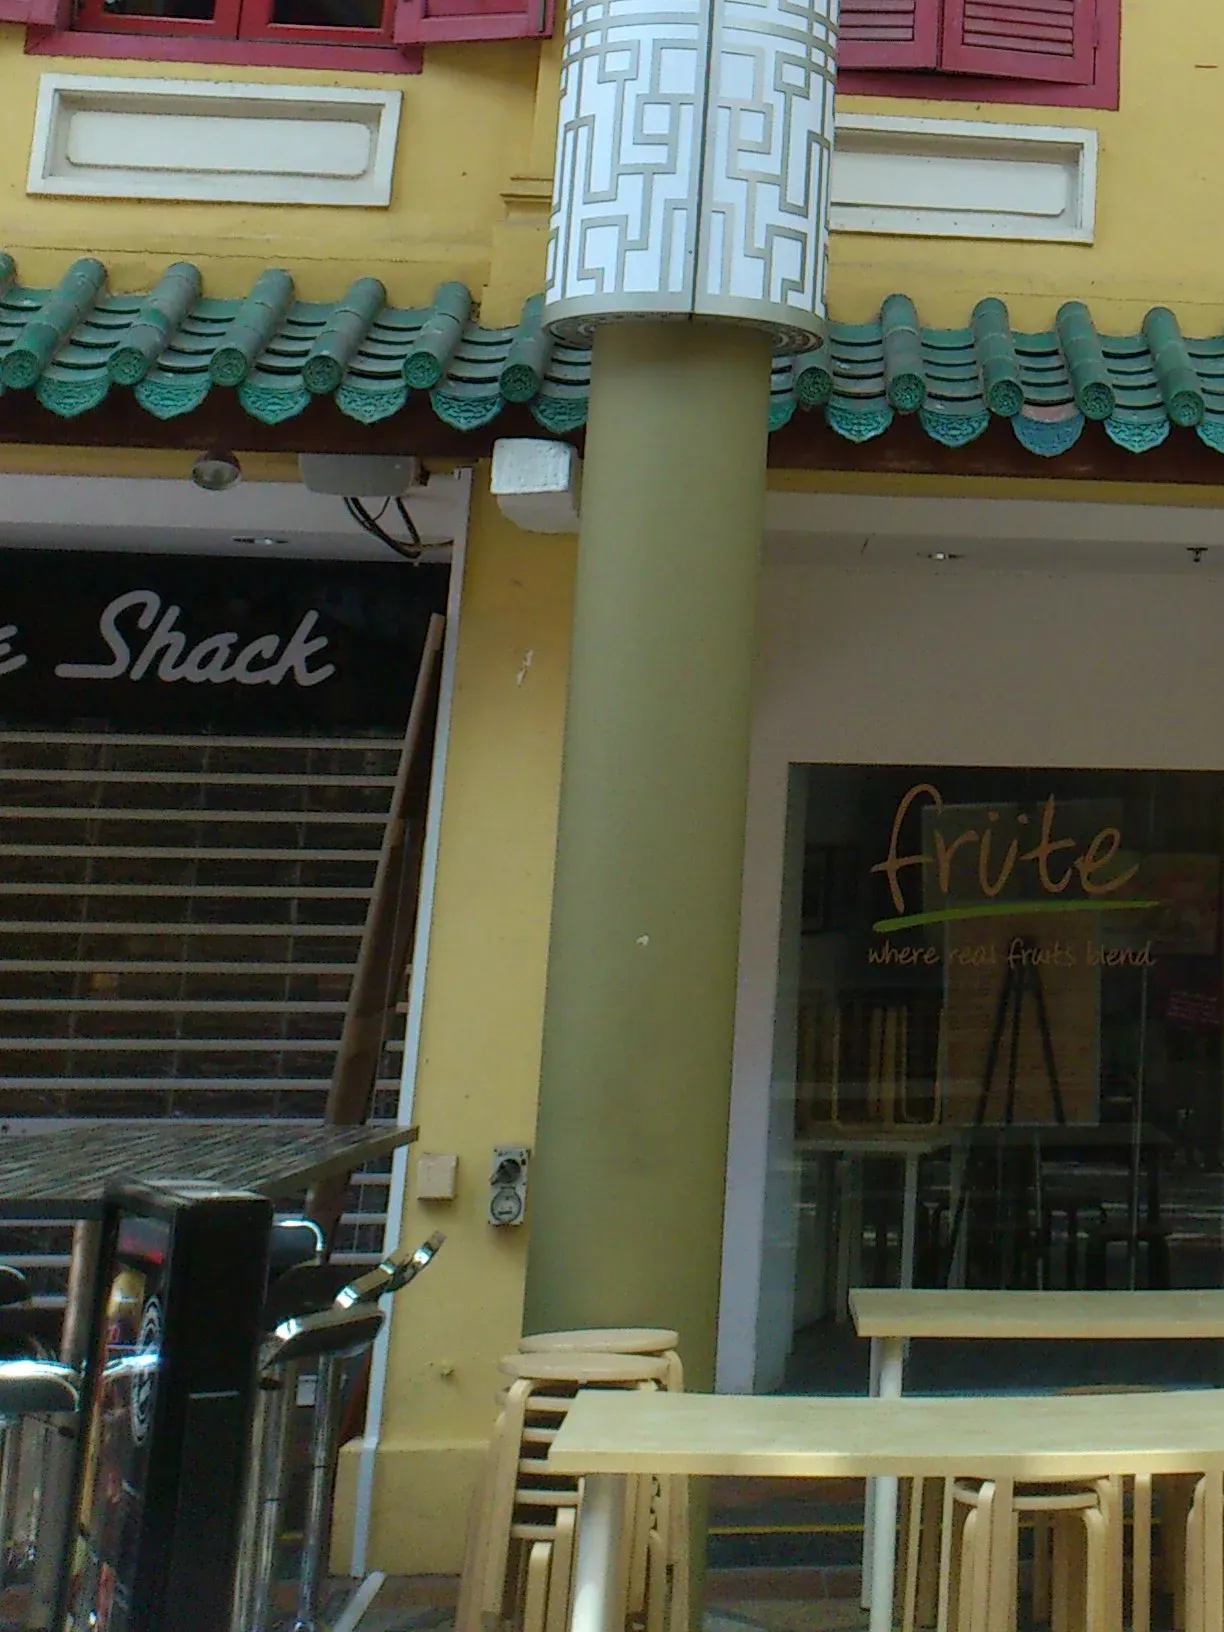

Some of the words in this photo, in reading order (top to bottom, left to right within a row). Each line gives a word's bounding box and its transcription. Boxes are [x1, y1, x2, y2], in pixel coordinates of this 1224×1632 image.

[55, 590, 335, 687] Shack
[870, 784, 1139, 913] früte
[868, 939, 940, 965] where
[948, 942, 996, 965] real
[1007, 937, 1075, 968] fruits
[1086, 940, 1157, 966] blend
